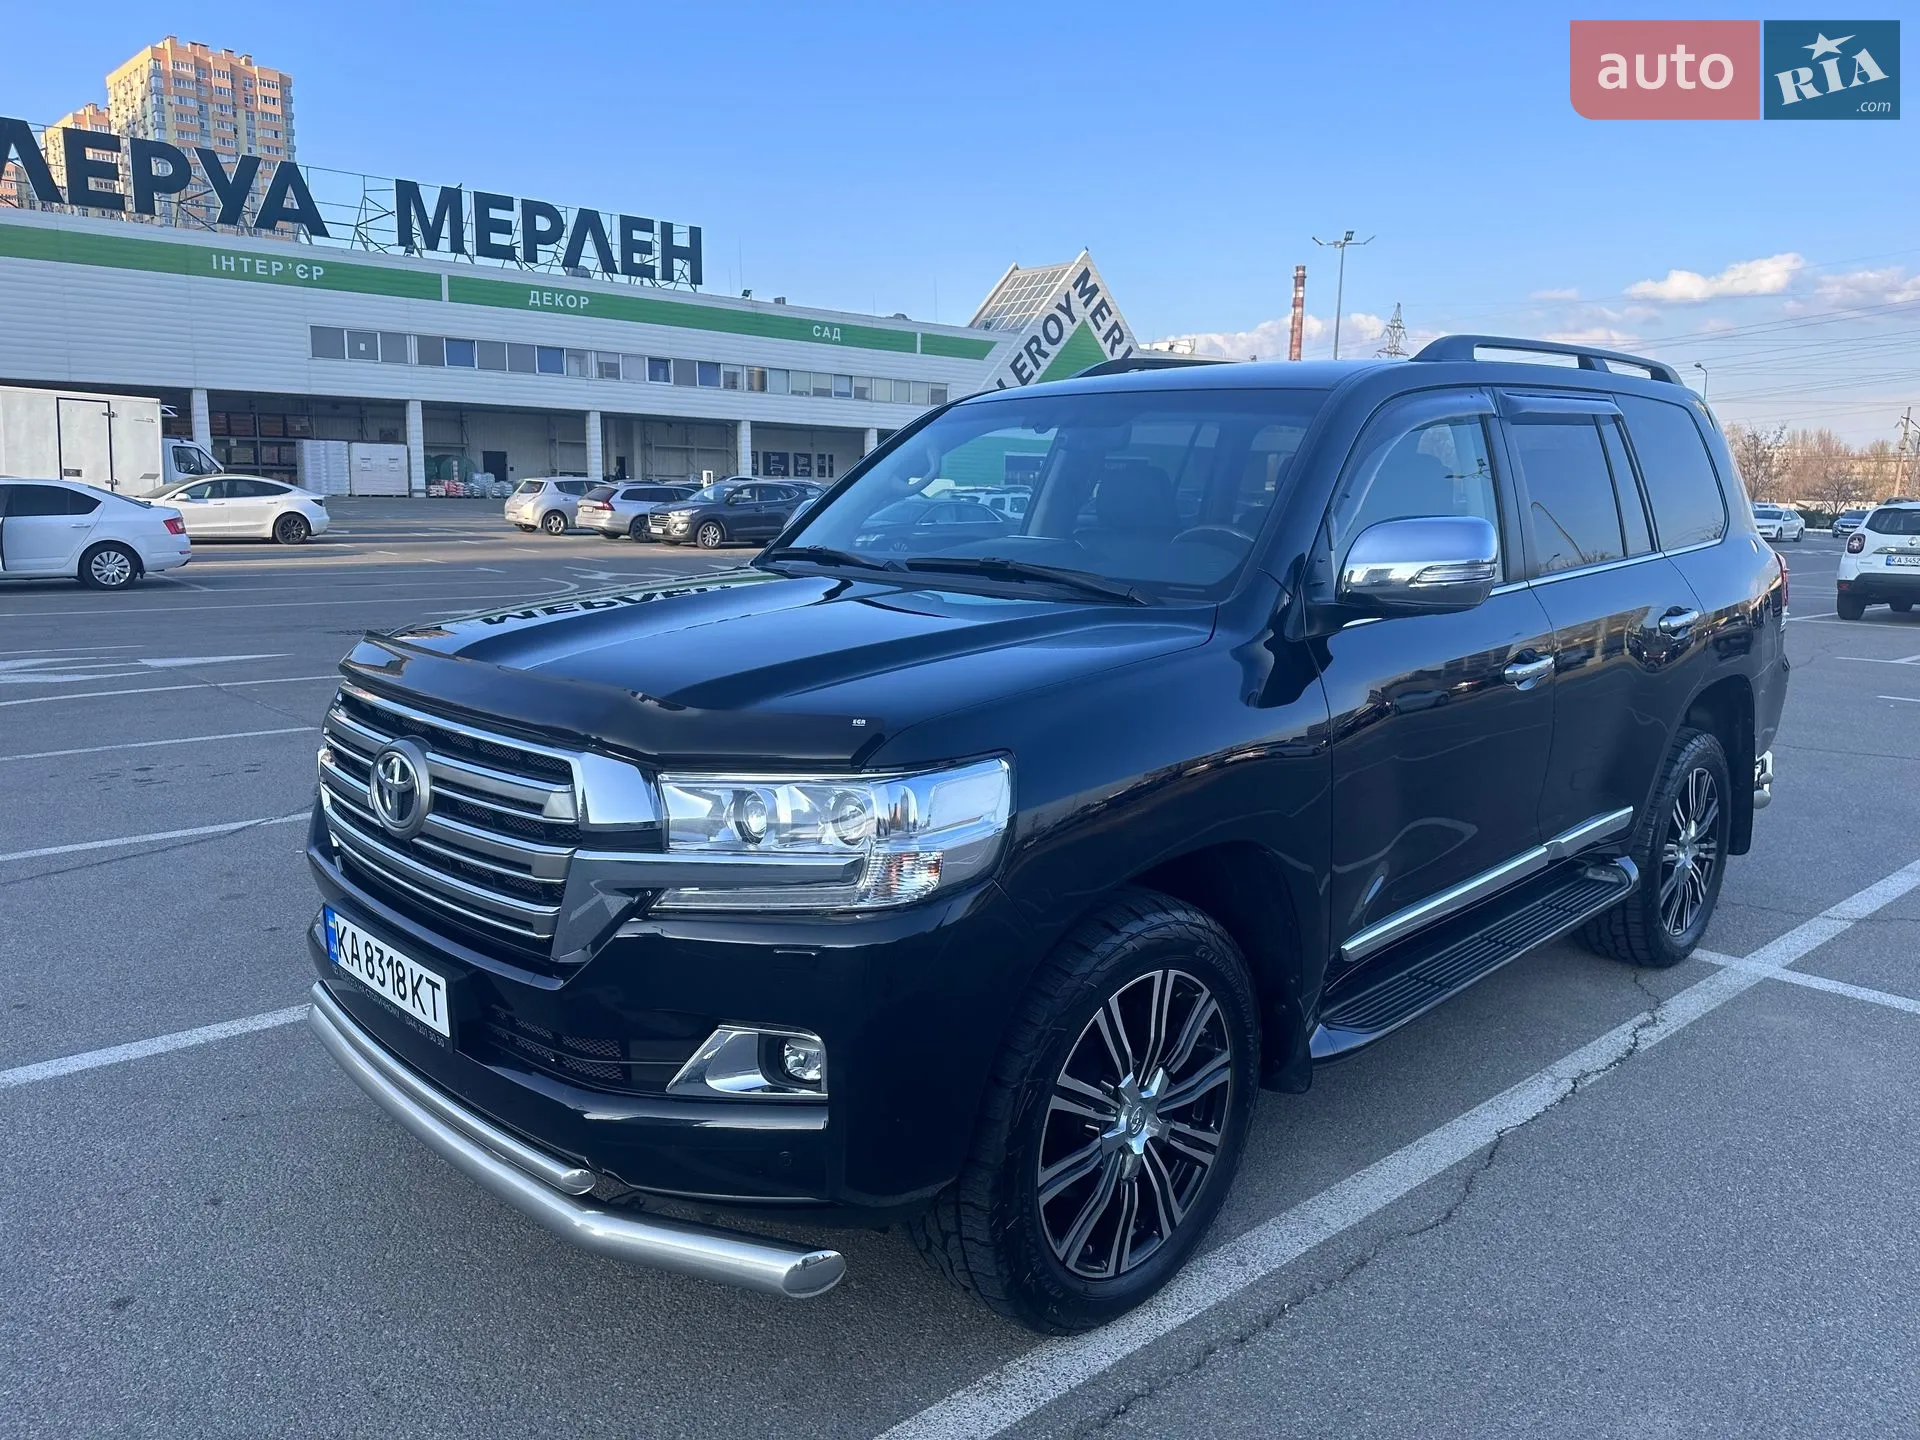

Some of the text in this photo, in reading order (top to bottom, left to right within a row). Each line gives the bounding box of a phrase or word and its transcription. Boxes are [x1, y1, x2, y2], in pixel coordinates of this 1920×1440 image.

[395, 179, 703, 285] МЕРЛЕН
[529, 290, 589, 309] ДЕКОР
[812, 325, 841, 341] САД
